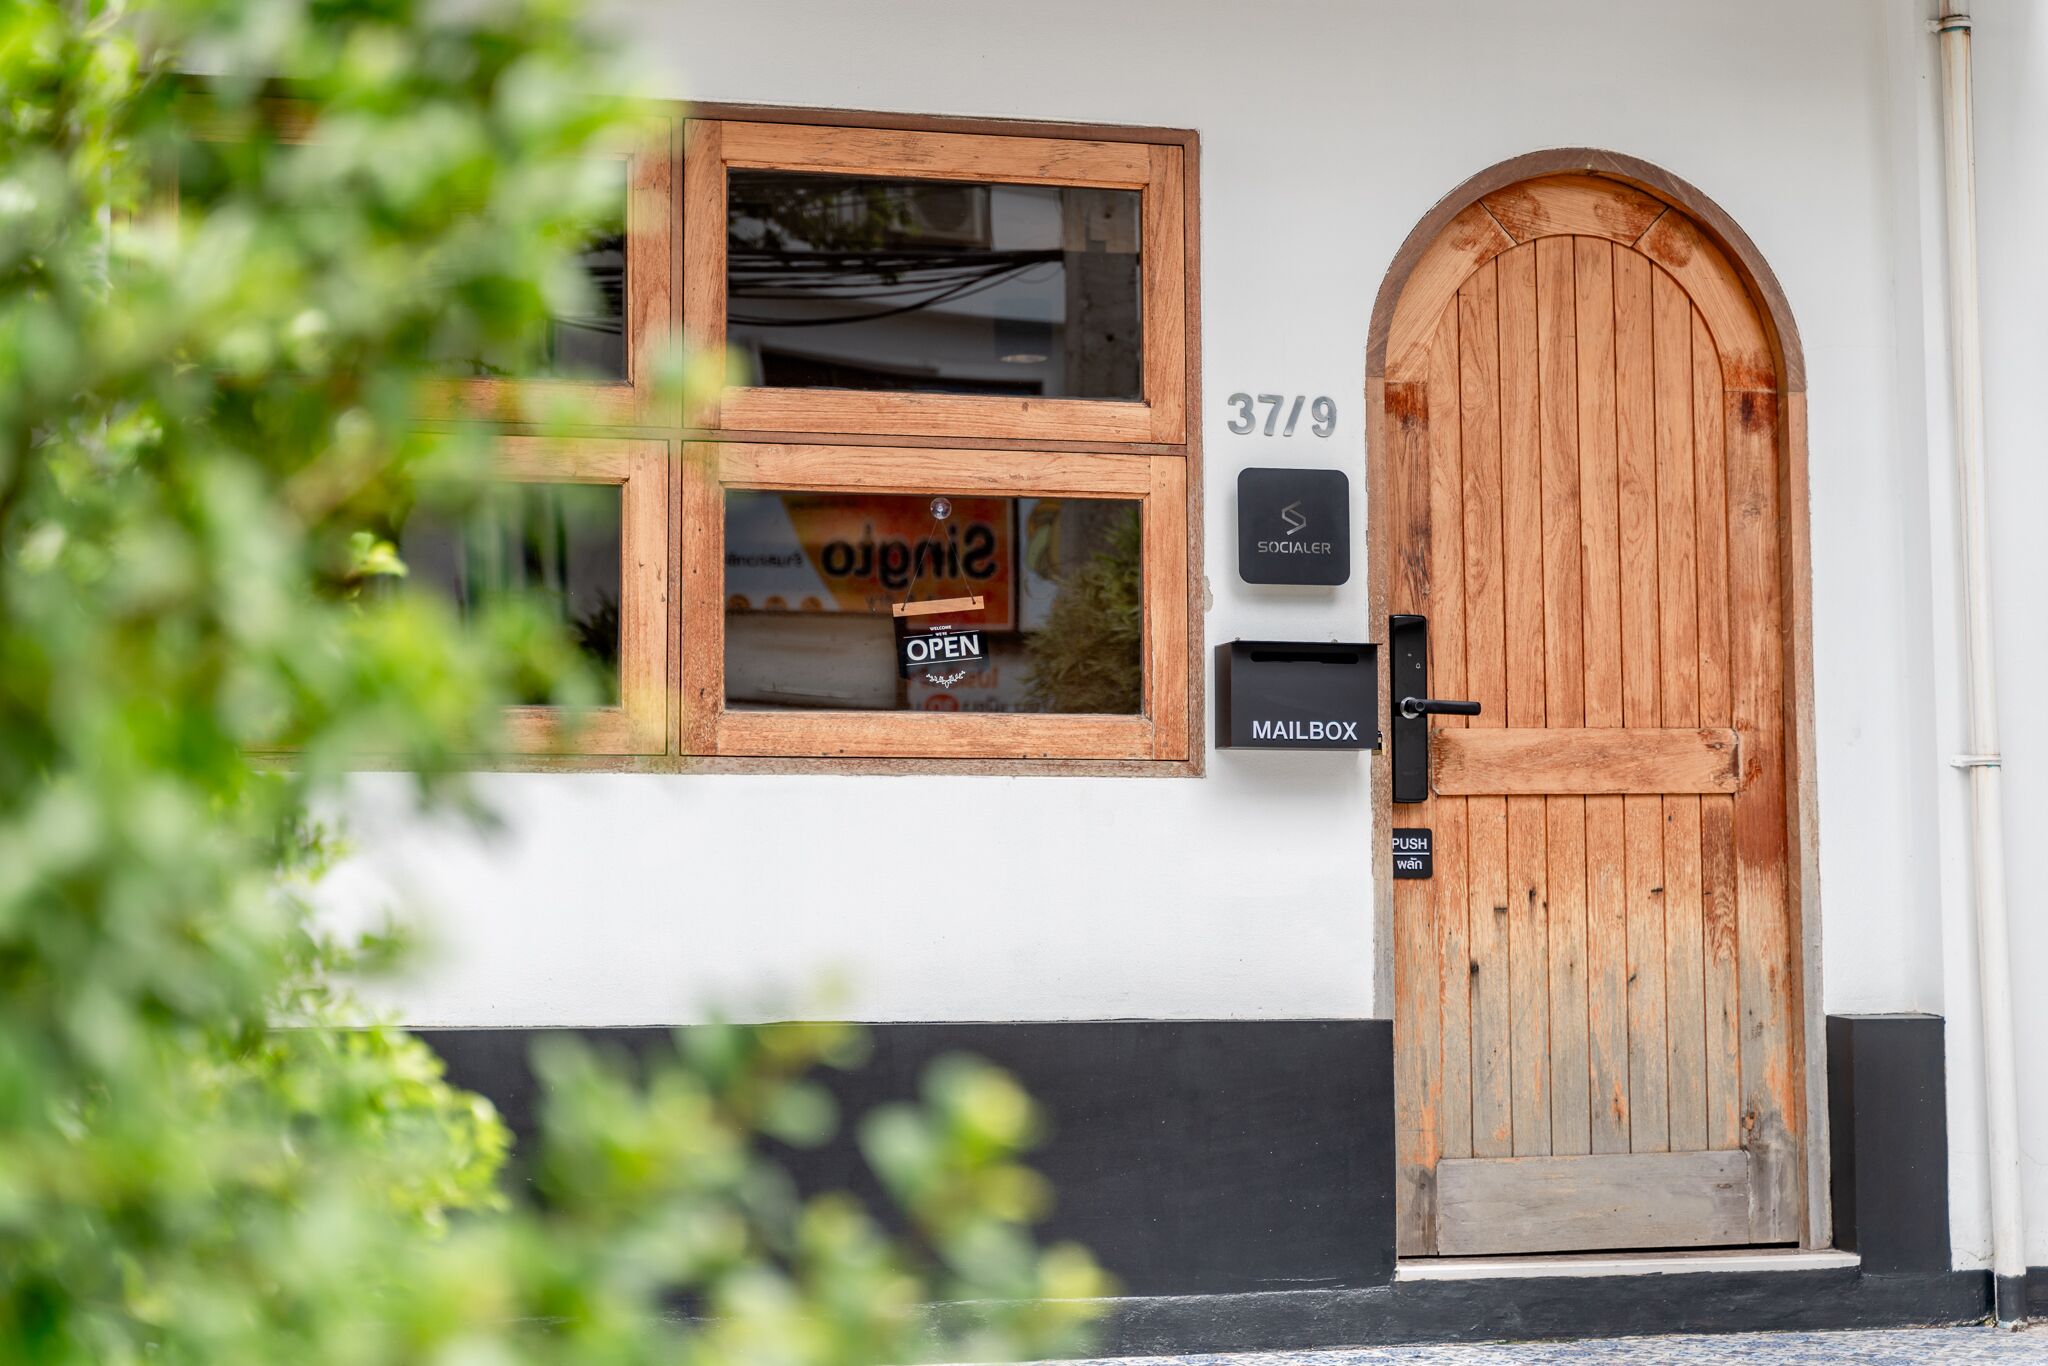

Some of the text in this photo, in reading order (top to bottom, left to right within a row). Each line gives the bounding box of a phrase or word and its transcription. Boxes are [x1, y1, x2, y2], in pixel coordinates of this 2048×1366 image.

[1227, 392, 1337, 438] 37/9
[1257, 541, 1331, 555] SOCIALER
[907, 635, 980, 661] OPEN
[1252, 720, 1358, 741] MAILBOX
[1392, 838, 1428, 850] PUSH
